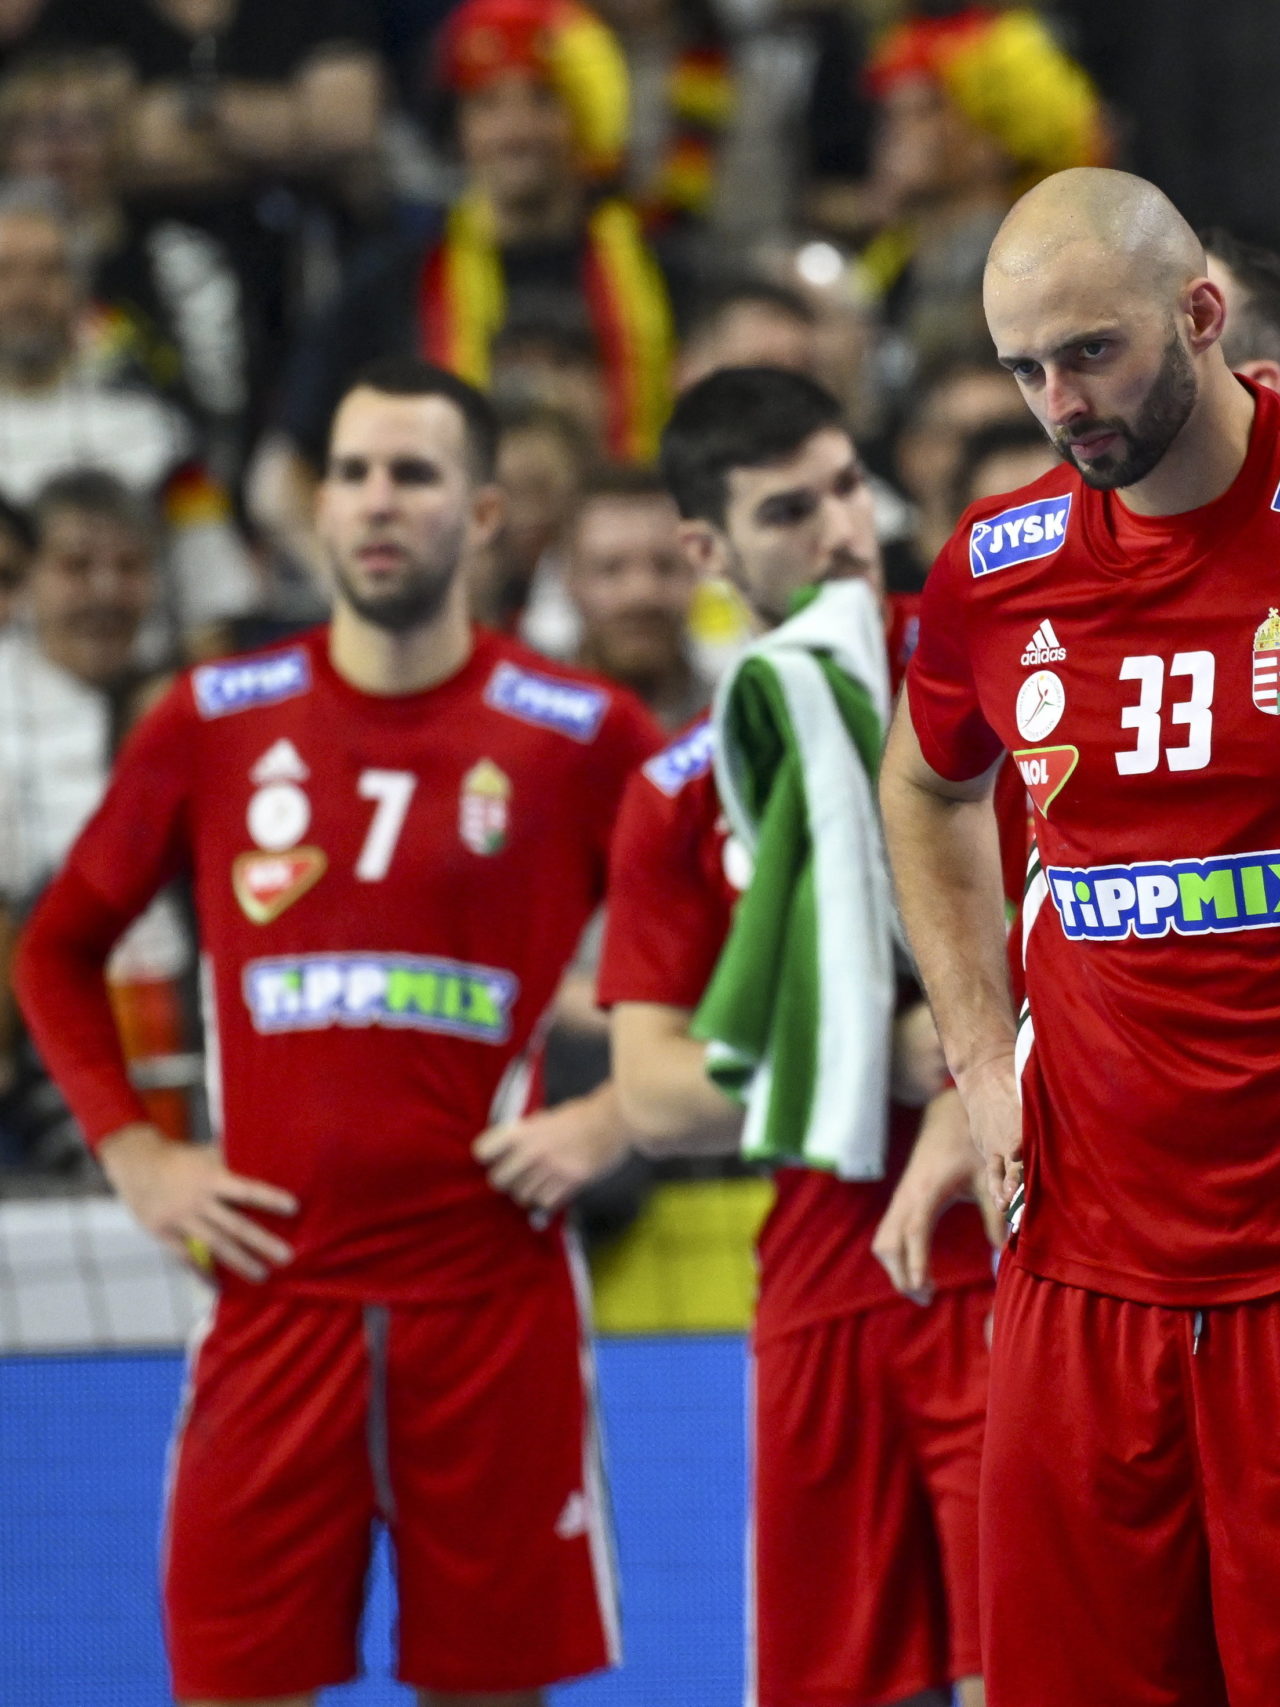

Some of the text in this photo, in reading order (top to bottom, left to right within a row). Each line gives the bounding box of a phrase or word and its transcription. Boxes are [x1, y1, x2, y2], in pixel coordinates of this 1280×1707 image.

[990, 509, 1066, 554] JYSK
[1021, 647, 1066, 666] adidas
[1115, 650, 1215, 776] 33
[355, 768, 417, 883] 7
